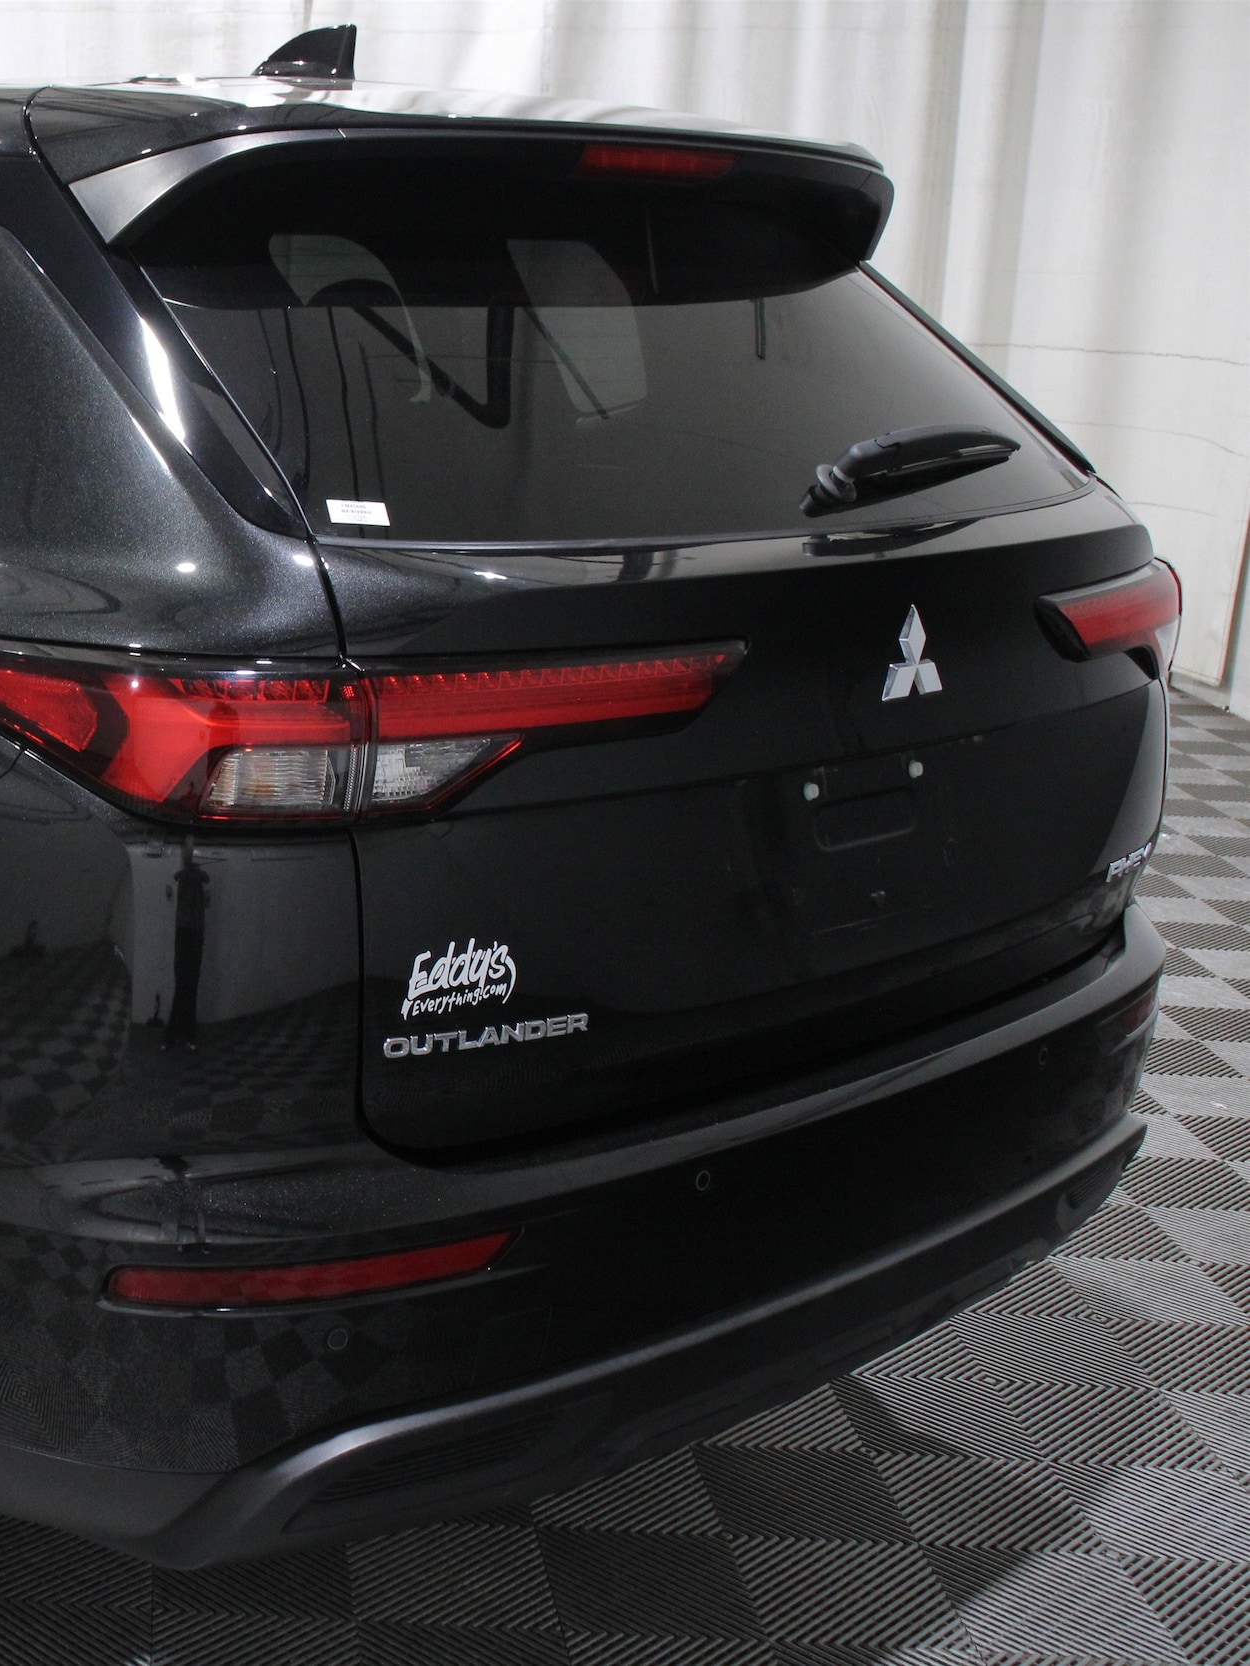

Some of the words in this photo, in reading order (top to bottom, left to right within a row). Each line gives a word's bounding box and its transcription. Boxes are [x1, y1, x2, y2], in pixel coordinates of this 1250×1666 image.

[408, 938, 509, 1000] Eddy's
[412, 982, 508, 1017] Everything.com
[383, 1012, 589, 1059] OUTLANDER
